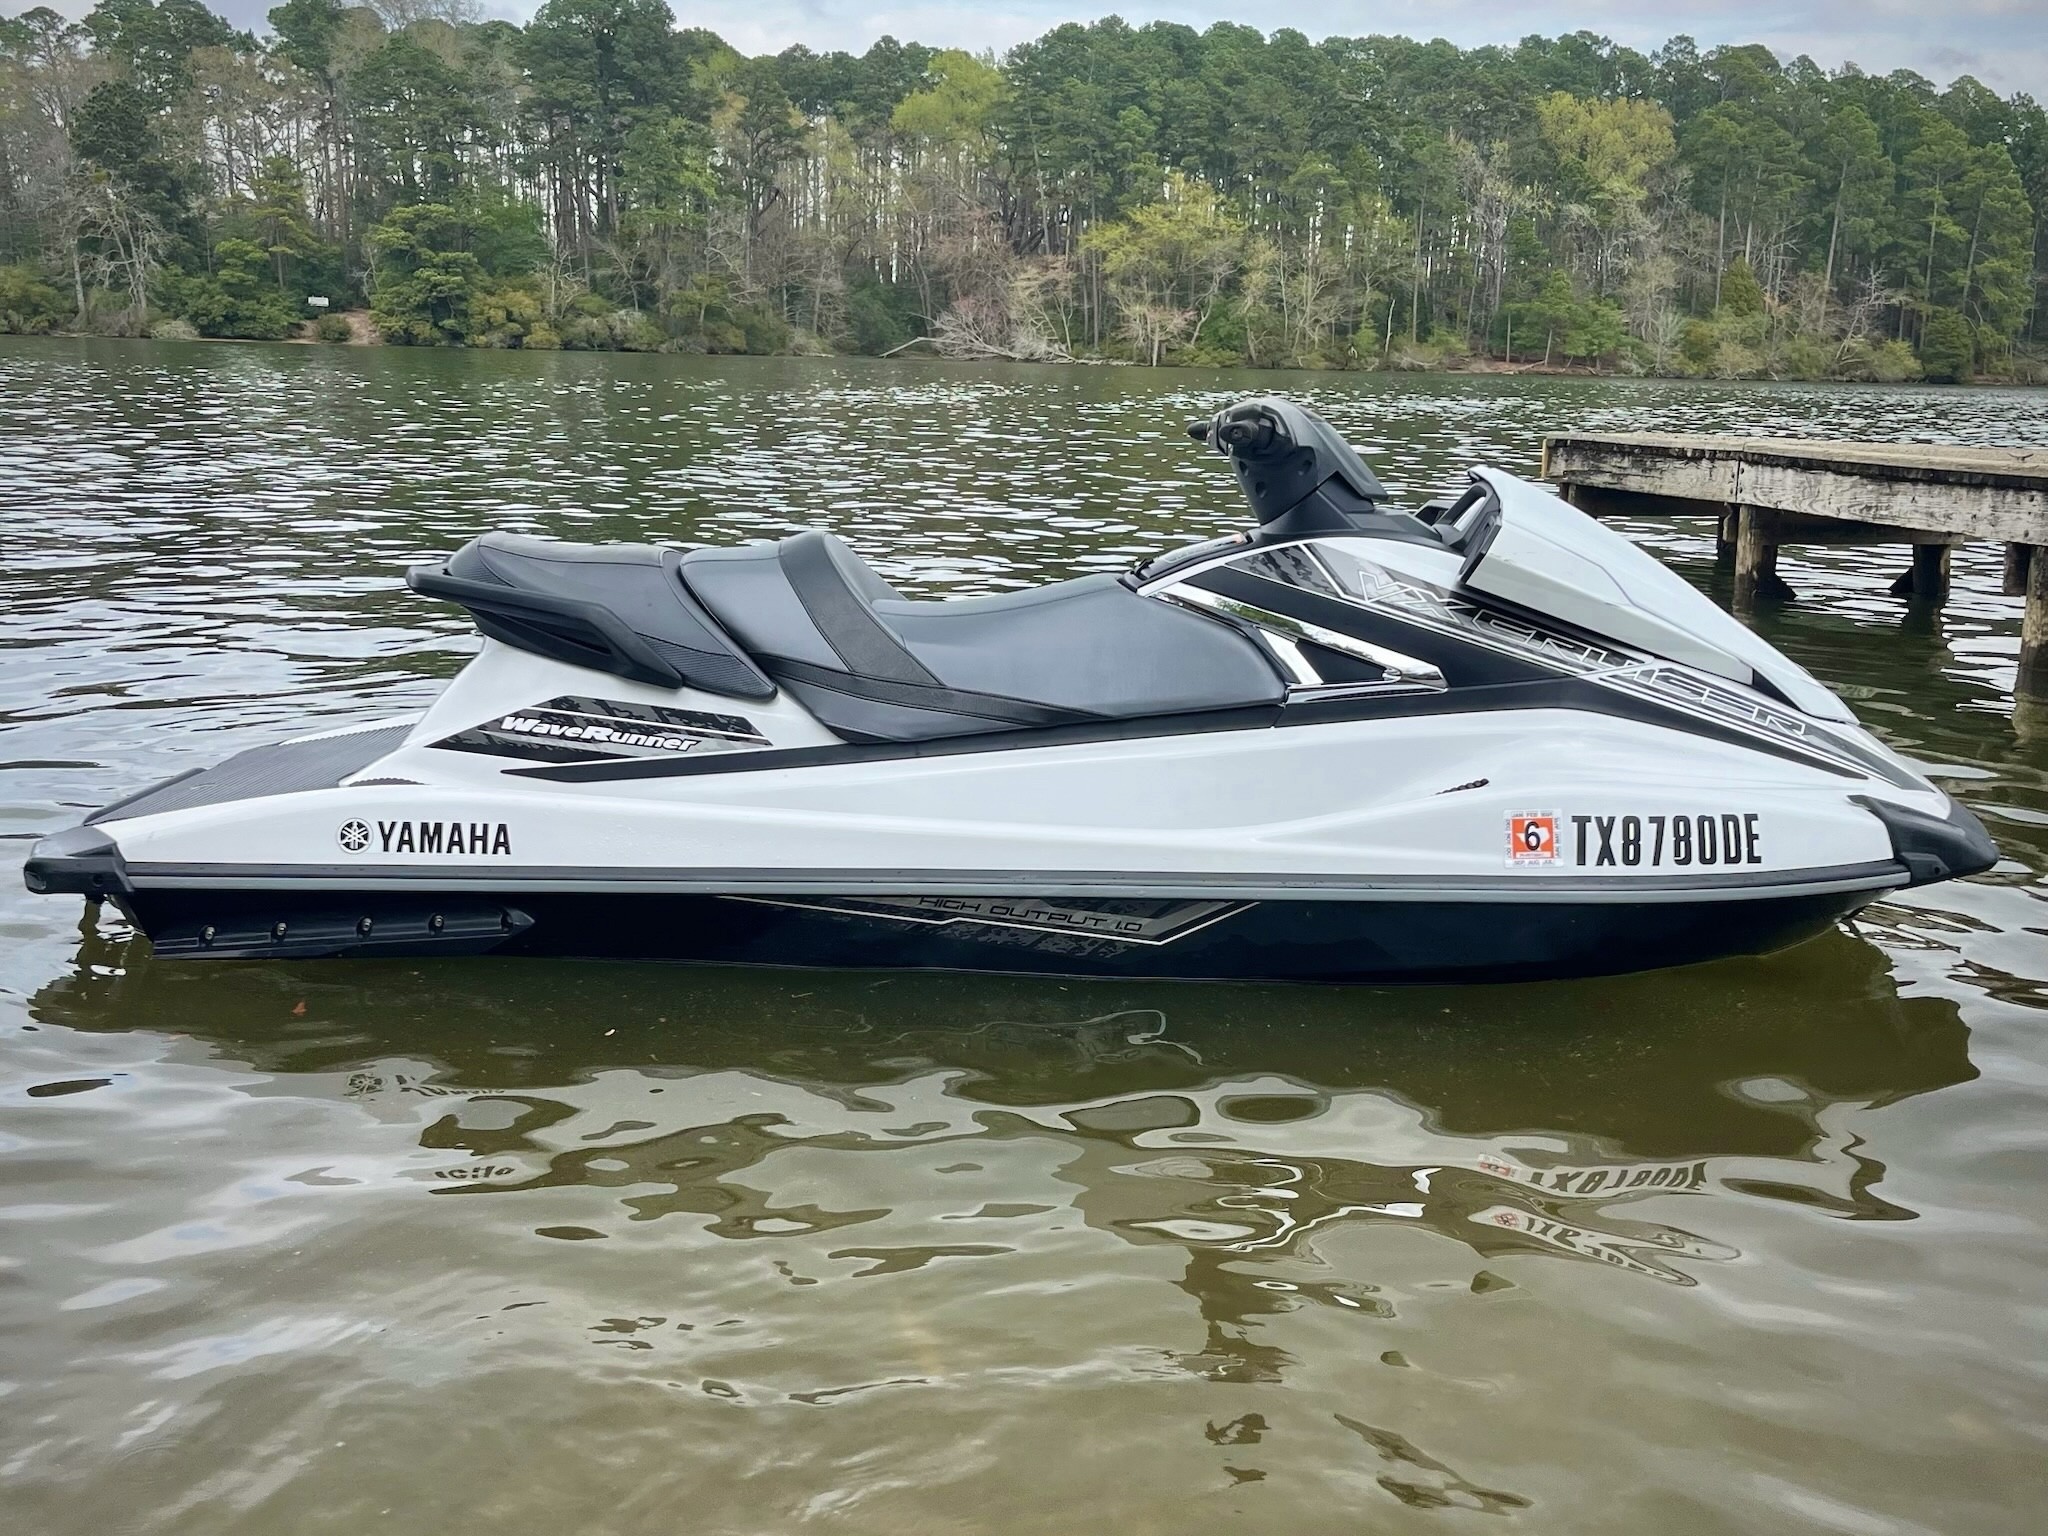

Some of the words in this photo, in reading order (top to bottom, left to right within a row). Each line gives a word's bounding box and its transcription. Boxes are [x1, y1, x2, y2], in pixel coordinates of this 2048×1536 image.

[1471, 607, 1807, 740] CRUISER
[500, 715, 700, 752] WaveRunner
[377, 820, 512, 855] YAMAHA
[1525, 821, 1541, 851] 6
[1571, 813, 1762, 866] TX8780DE
[918, 897, 982, 912] HIGH
[989, 905, 1108, 927] OUTPUT
[1114, 920, 1143, 932] 1.0
